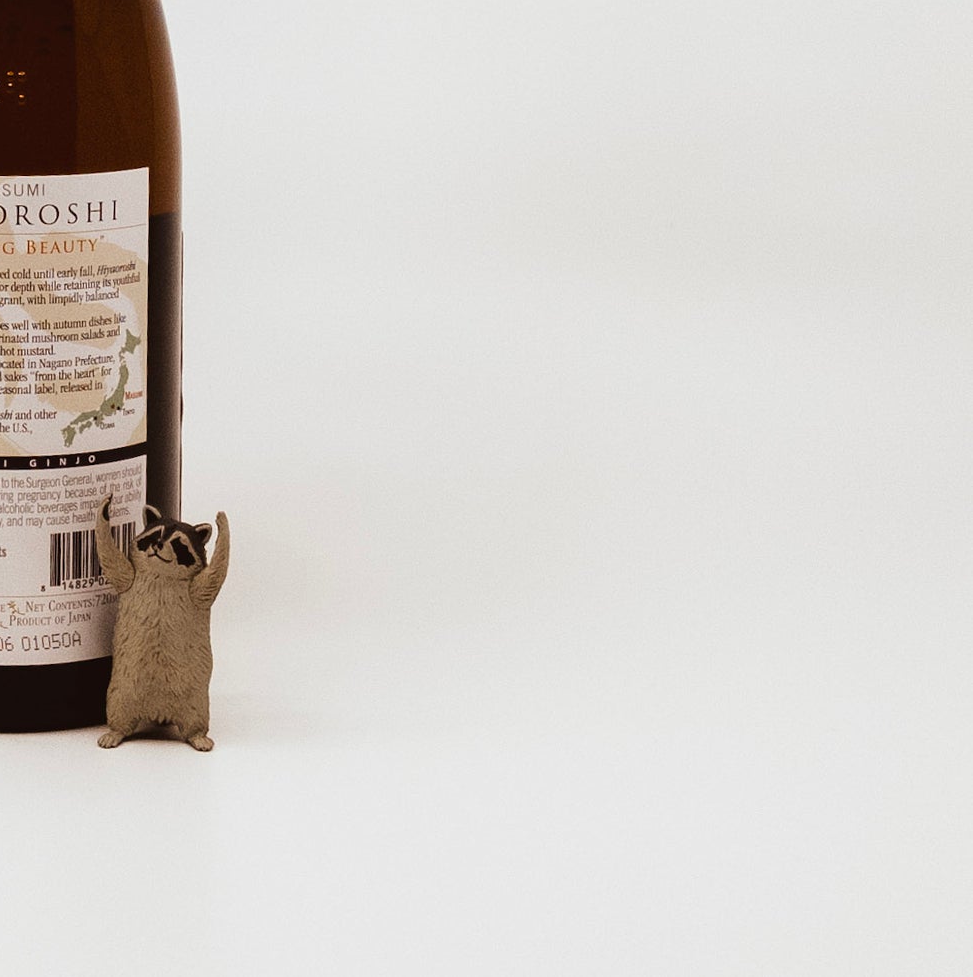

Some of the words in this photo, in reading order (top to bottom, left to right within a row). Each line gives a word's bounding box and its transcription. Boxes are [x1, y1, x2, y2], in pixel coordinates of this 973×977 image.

[13, 269, 31, 278] cold
[34, 269, 54, 278] until
[57, 267, 78, 279] early
[80, 266, 95, 277] fall,
[11, 282, 35, 294] depth
[38, 281, 61, 291] while
[64, 279, 100, 292] retaining
[103, 278, 111, 287] its
[113, 272, 140, 288] youthful
[27, 294, 46, 304] with
[49, 292, 83, 306] limpidly
[85, 288, 119, 302] balanced
[12, 320, 28, 330] well
[32, 319, 51, 330] with
[53, 319, 86, 329] autumn
[89, 317, 112, 327] dishes
[114, 313, 126, 323] like
[32, 332, 79, 343] mushroom
[81, 329, 104, 340] salads
[107, 326, 120, 337] and
[0, 346, 14, 355] hot
[17, 345, 55, 355] mustard.
[28, 358, 36, 368] in
[39, 358, 72, 370] Nagano
[75, 354, 115, 365] Prefecture,
[5, 371, 27, 381] sakes
[59, 369, 71, 380] the
[101, 365, 111, 376] for
[35, 383, 58, 394] label,
[60, 381, 92, 393] released
[95, 380, 103, 389] in
[15, 411, 31, 420] and
[34, 411, 57, 419] other
[29, 455, 96, 467] GINJO
[1, 479, 9, 488] to
[11, 479, 25, 488] the
[26, 477, 61, 490] Surgeon
[62, 474, 94, 486] General,
[97, 470, 121, 482] women
[122, 464, 142, 478] should
[17, 491, 61, 503] pregnancy
[65, 488, 97, 499] because
[99, 485, 107, 495] of
[123, 479, 133, 490] risk
[37, 501, 78, 515] beverages
[7, 517, 22, 527] and
[26, 518, 42, 528] may
[46, 515, 70, 525] cause
[73, 511, 95, 522] health
